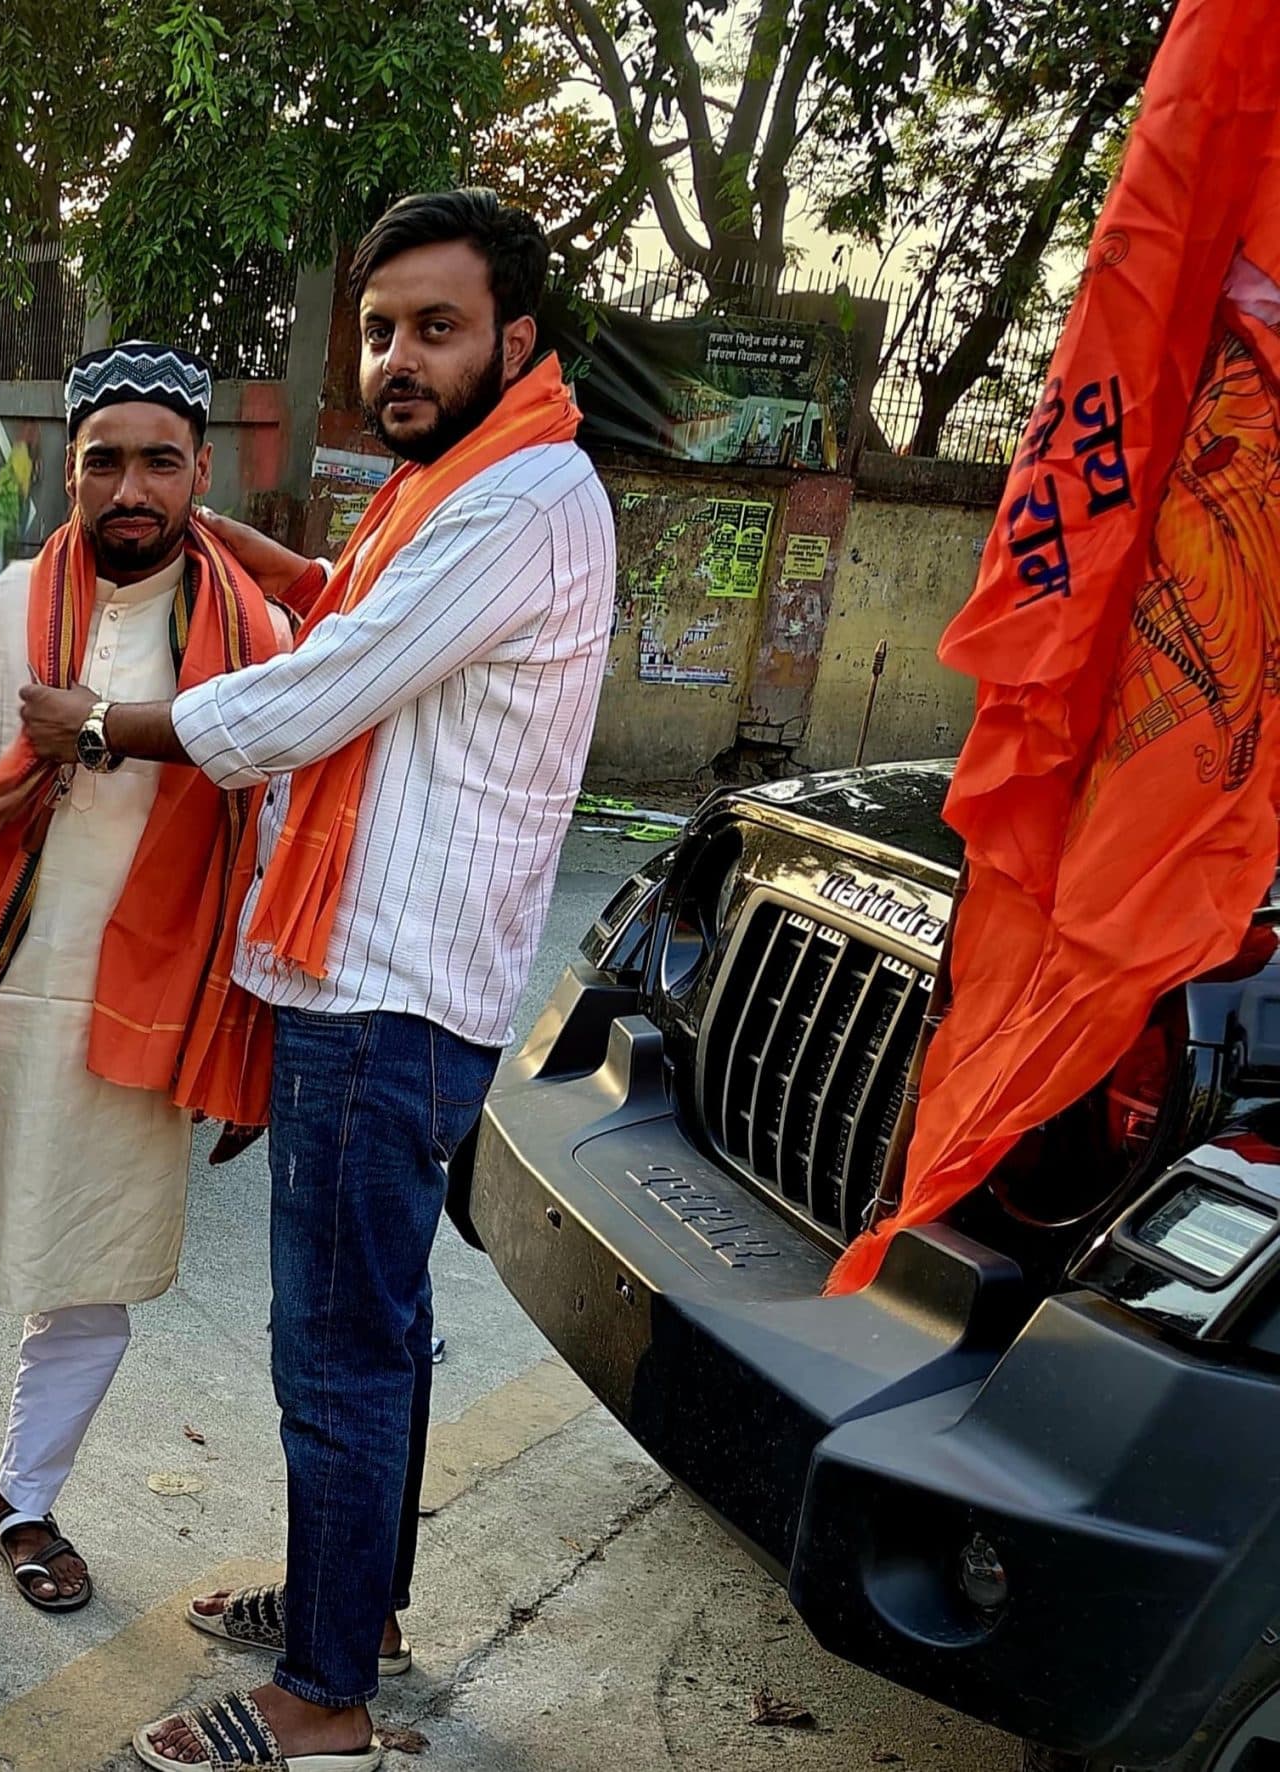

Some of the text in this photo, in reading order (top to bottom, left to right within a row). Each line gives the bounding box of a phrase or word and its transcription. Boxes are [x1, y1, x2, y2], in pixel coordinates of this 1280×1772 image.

[738, 348, 768, 363] विद्यालय
[769, 351, 777, 363] के
[779, 353, 802, 365] सामने
[762, 334, 779, 346] पार्क
[780, 335, 787, 347] के
[1073, 376, 1136, 519] जय
[1008, 473, 1072, 609] राम
[816, 871, 948, 946] Mahindra
